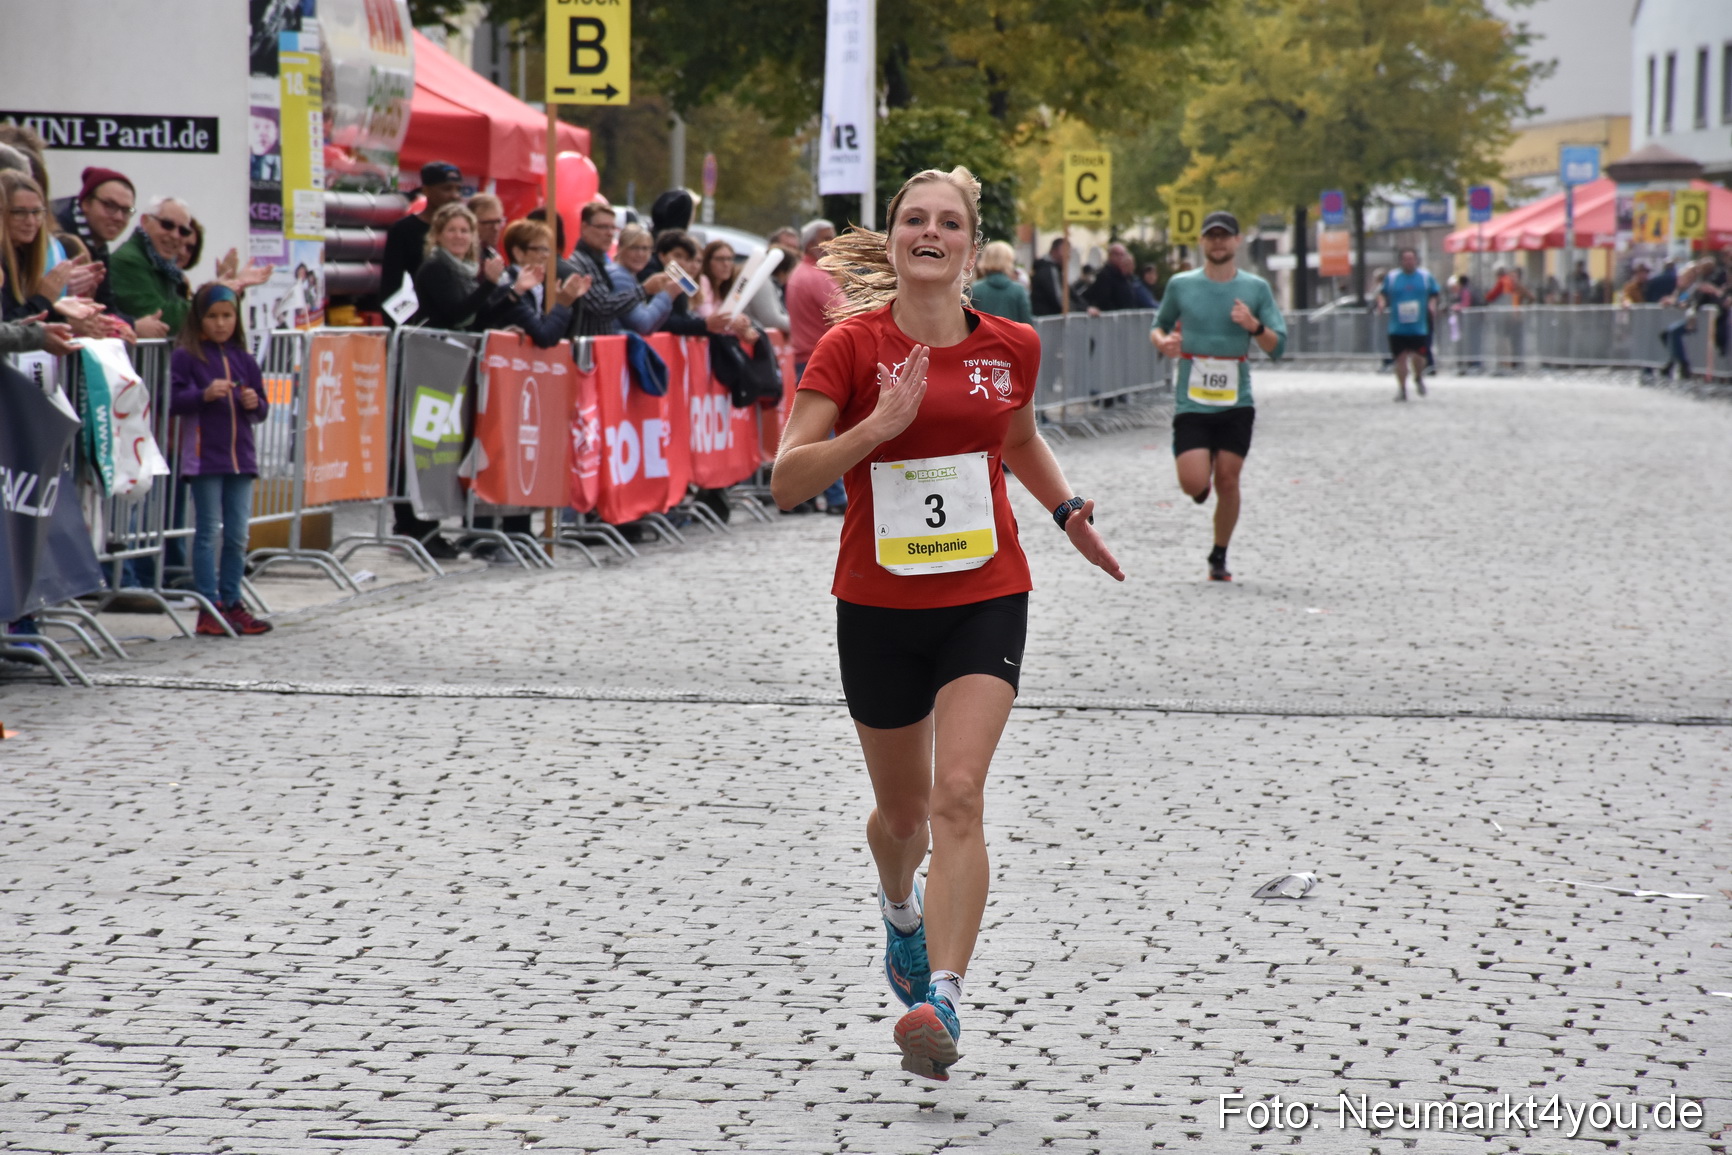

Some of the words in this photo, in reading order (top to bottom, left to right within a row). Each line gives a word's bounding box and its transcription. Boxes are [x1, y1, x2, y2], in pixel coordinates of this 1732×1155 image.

[568, 15, 608, 76] B
[1076, 172, 1098, 205] C
[1177, 209, 1195, 233] D
[1683, 204, 1701, 229] D
[963, 359, 980, 367] TSV
[1202, 373, 1228, 389] 169
[917, 466, 959, 480] BOCK
[924, 493, 947, 529] 3
[907, 538, 968, 557] Stephanie
